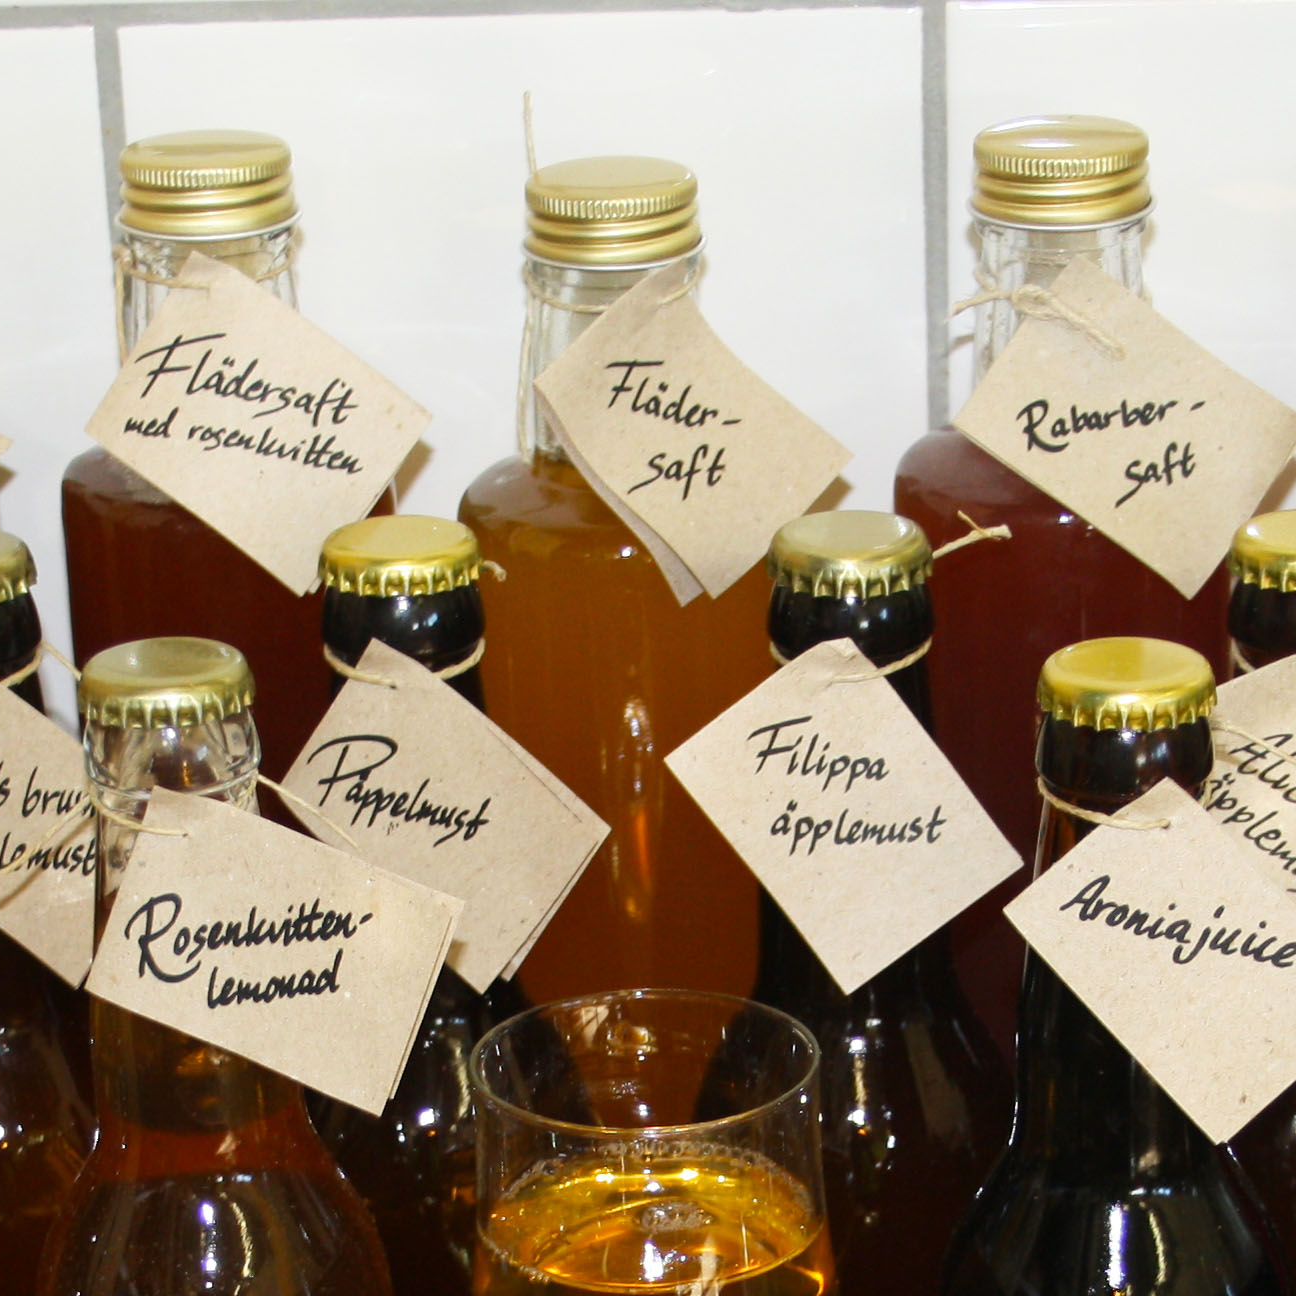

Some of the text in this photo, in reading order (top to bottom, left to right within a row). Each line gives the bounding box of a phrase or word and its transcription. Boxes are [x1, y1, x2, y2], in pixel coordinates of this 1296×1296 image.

[135, 333, 359, 425] Flädersaft
[606, 361, 742, 427] Fläder-
[124, 412, 363, 475] med rosenkvitten
[628, 445, 726, 500] saft
[1115, 449, 1196, 508] saft
[747, 715, 888, 791] Filippa
[770, 801, 946, 856] äpplemust
[125, 892, 373, 982] Rosenkvitten-
